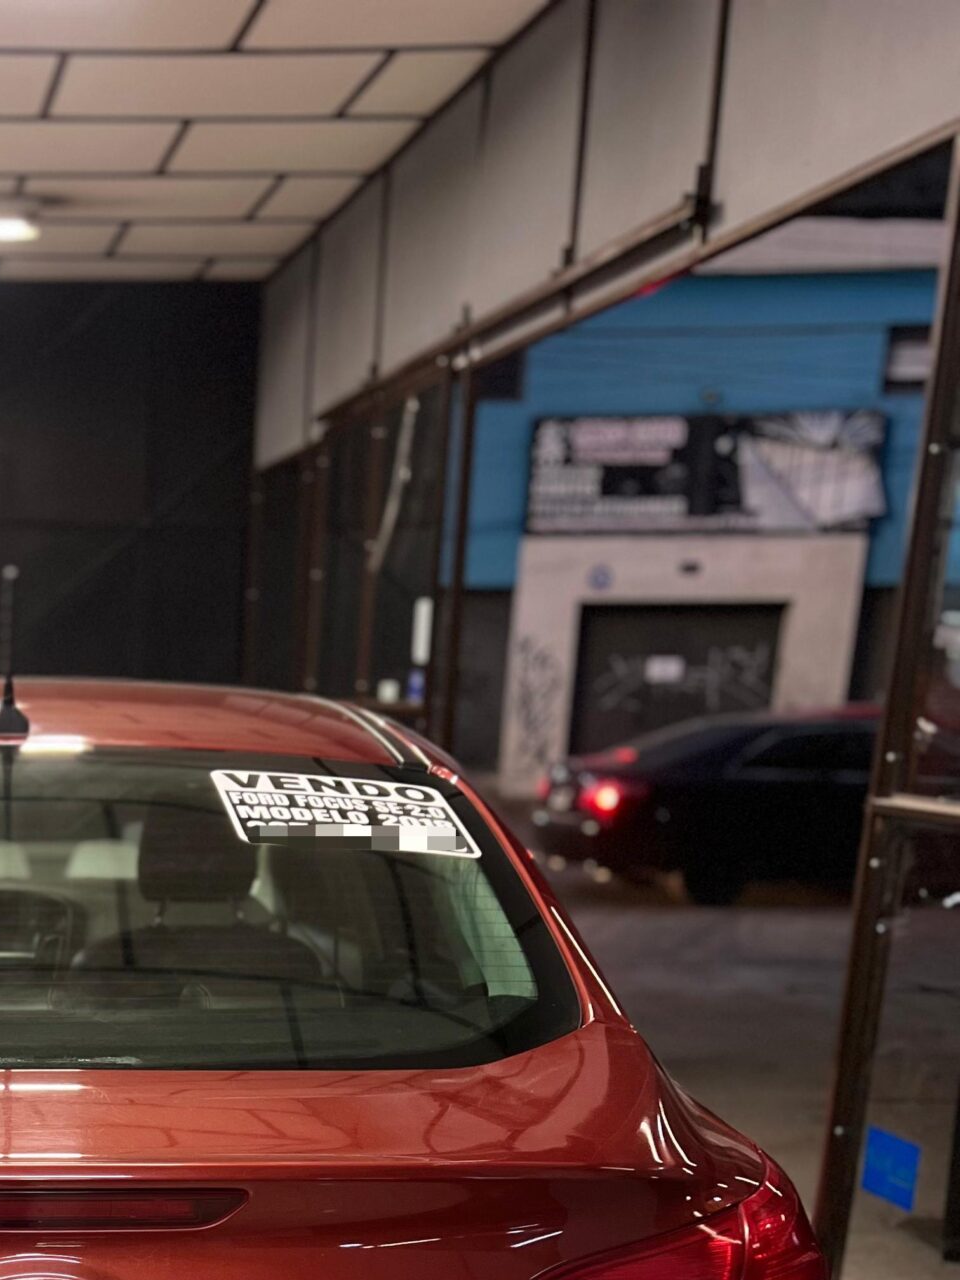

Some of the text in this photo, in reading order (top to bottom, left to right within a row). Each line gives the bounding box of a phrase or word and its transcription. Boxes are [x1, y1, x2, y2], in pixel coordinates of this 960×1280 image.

[223, 772, 437, 803] VENDO
[228, 791, 447, 820] FORD FOCUS SE 2.0
[236, 805, 370, 825] MODELO
